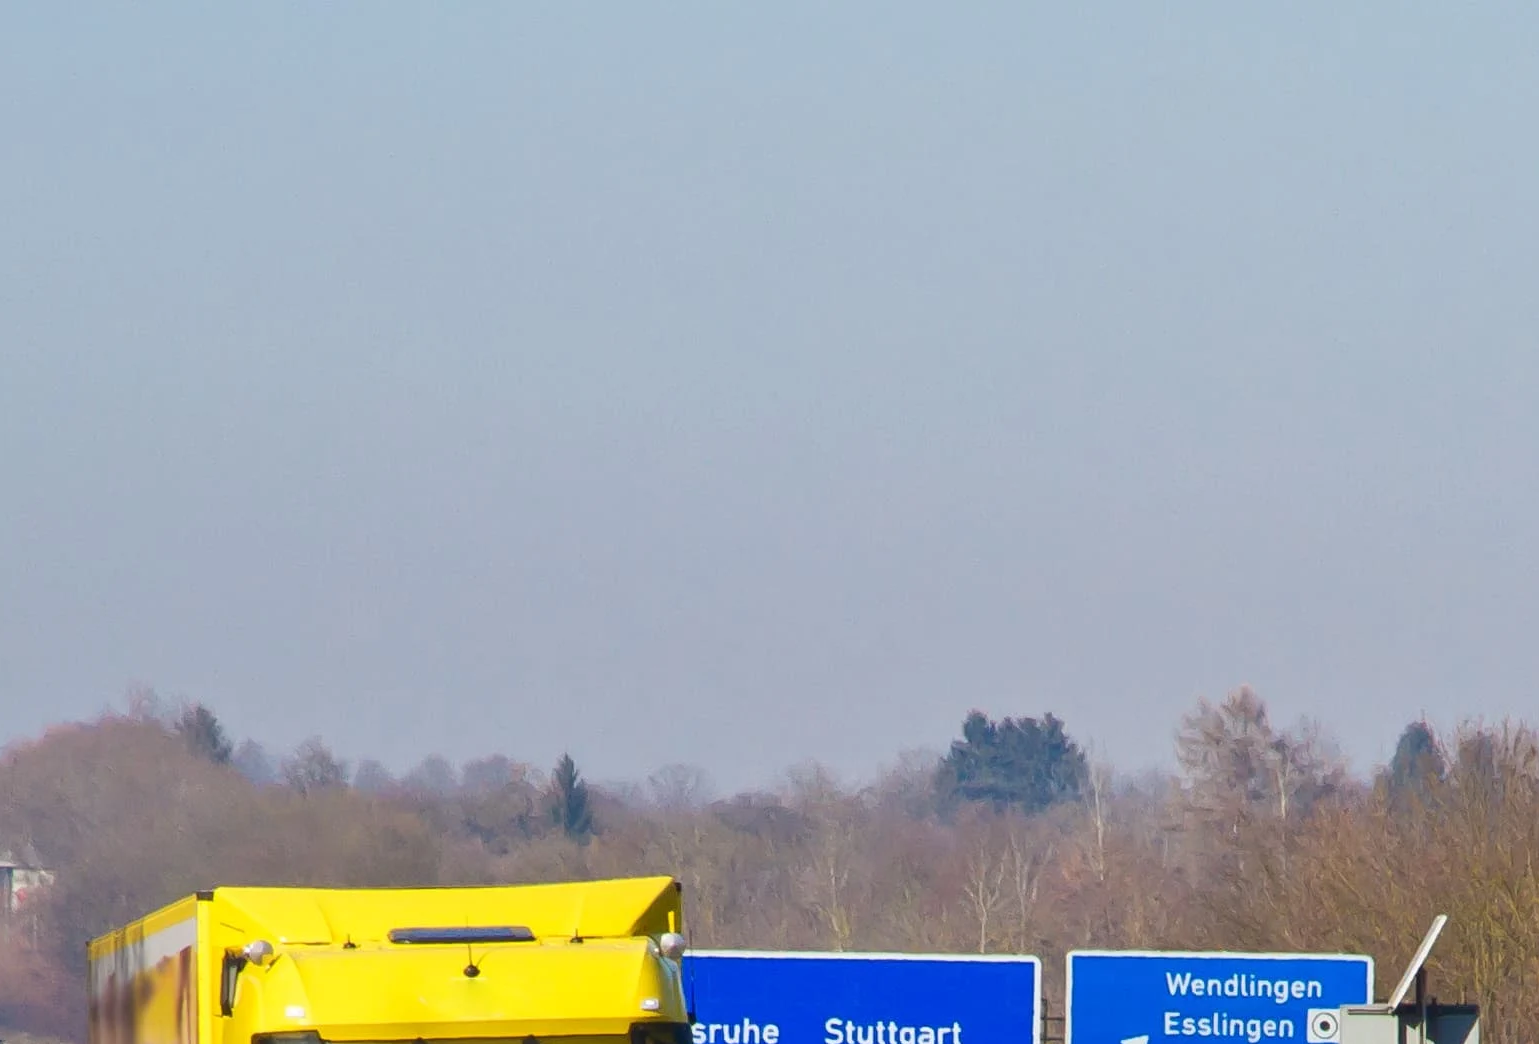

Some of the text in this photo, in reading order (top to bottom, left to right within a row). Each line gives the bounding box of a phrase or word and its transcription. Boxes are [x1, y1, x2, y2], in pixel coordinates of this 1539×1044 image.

[1166, 972, 1322, 1004] Wendlingen
[691, 1017, 780, 1044] sruhe
[1164, 1011, 1294, 1044] Esslingen
